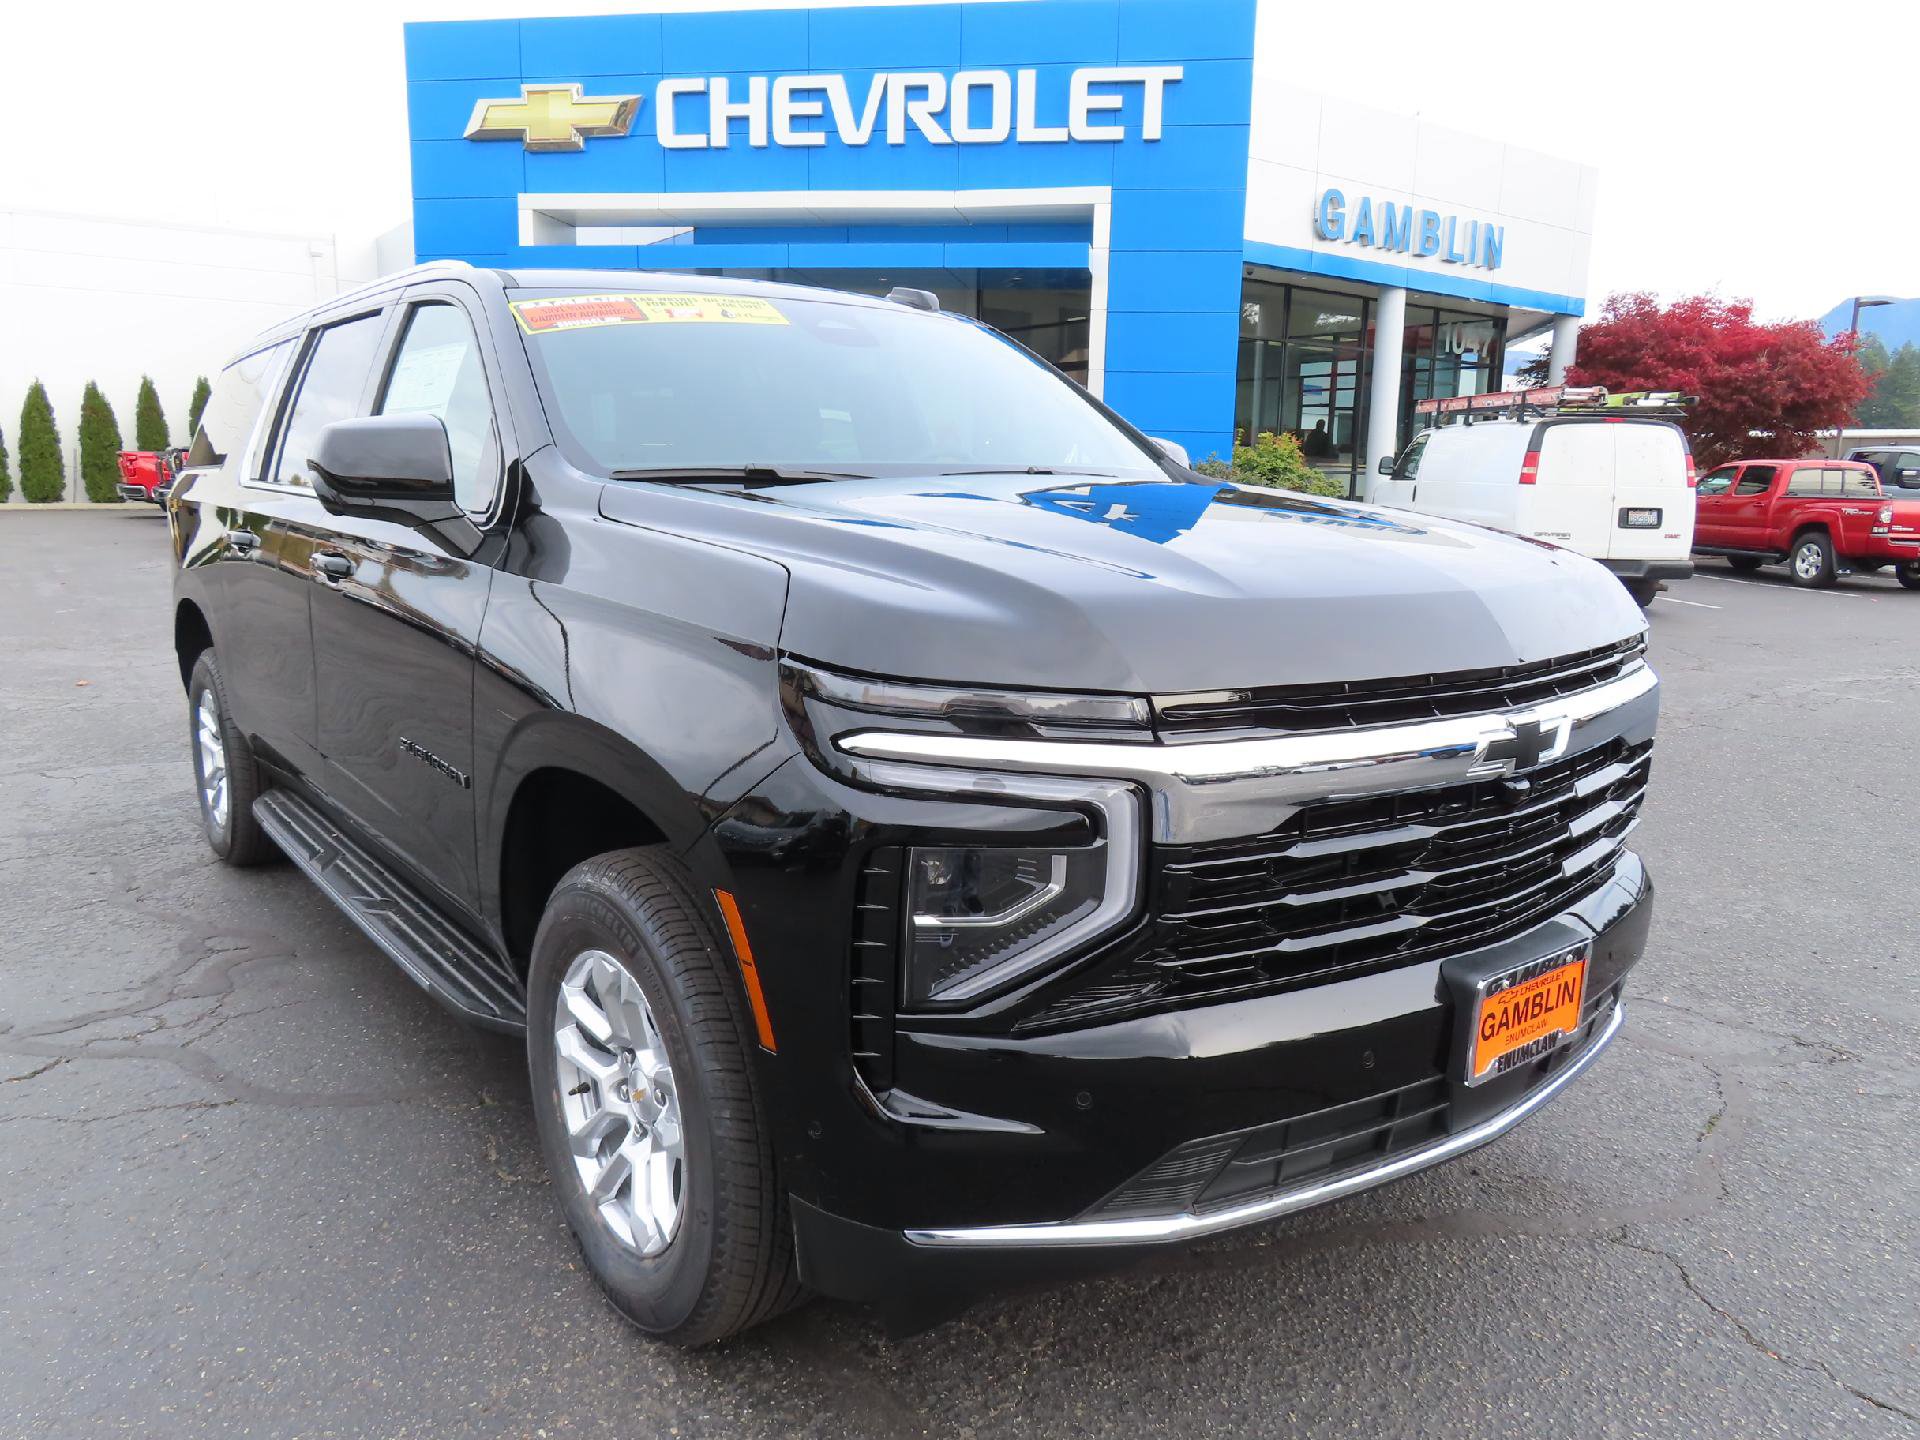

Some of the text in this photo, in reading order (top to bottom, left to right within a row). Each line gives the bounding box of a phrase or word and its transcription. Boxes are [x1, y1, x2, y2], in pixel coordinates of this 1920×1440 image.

[655, 66, 1184, 148] CHEVROLET
[1314, 188, 1504, 271] GAMBLIN
[1481, 977, 1576, 1041] GAMBLIN
[1520, 970, 1566, 995] CHEVROLET
[1497, 1030, 1558, 1072] ENUMCLAW
[1505, 1018, 1546, 1045] ENUMCLAW
